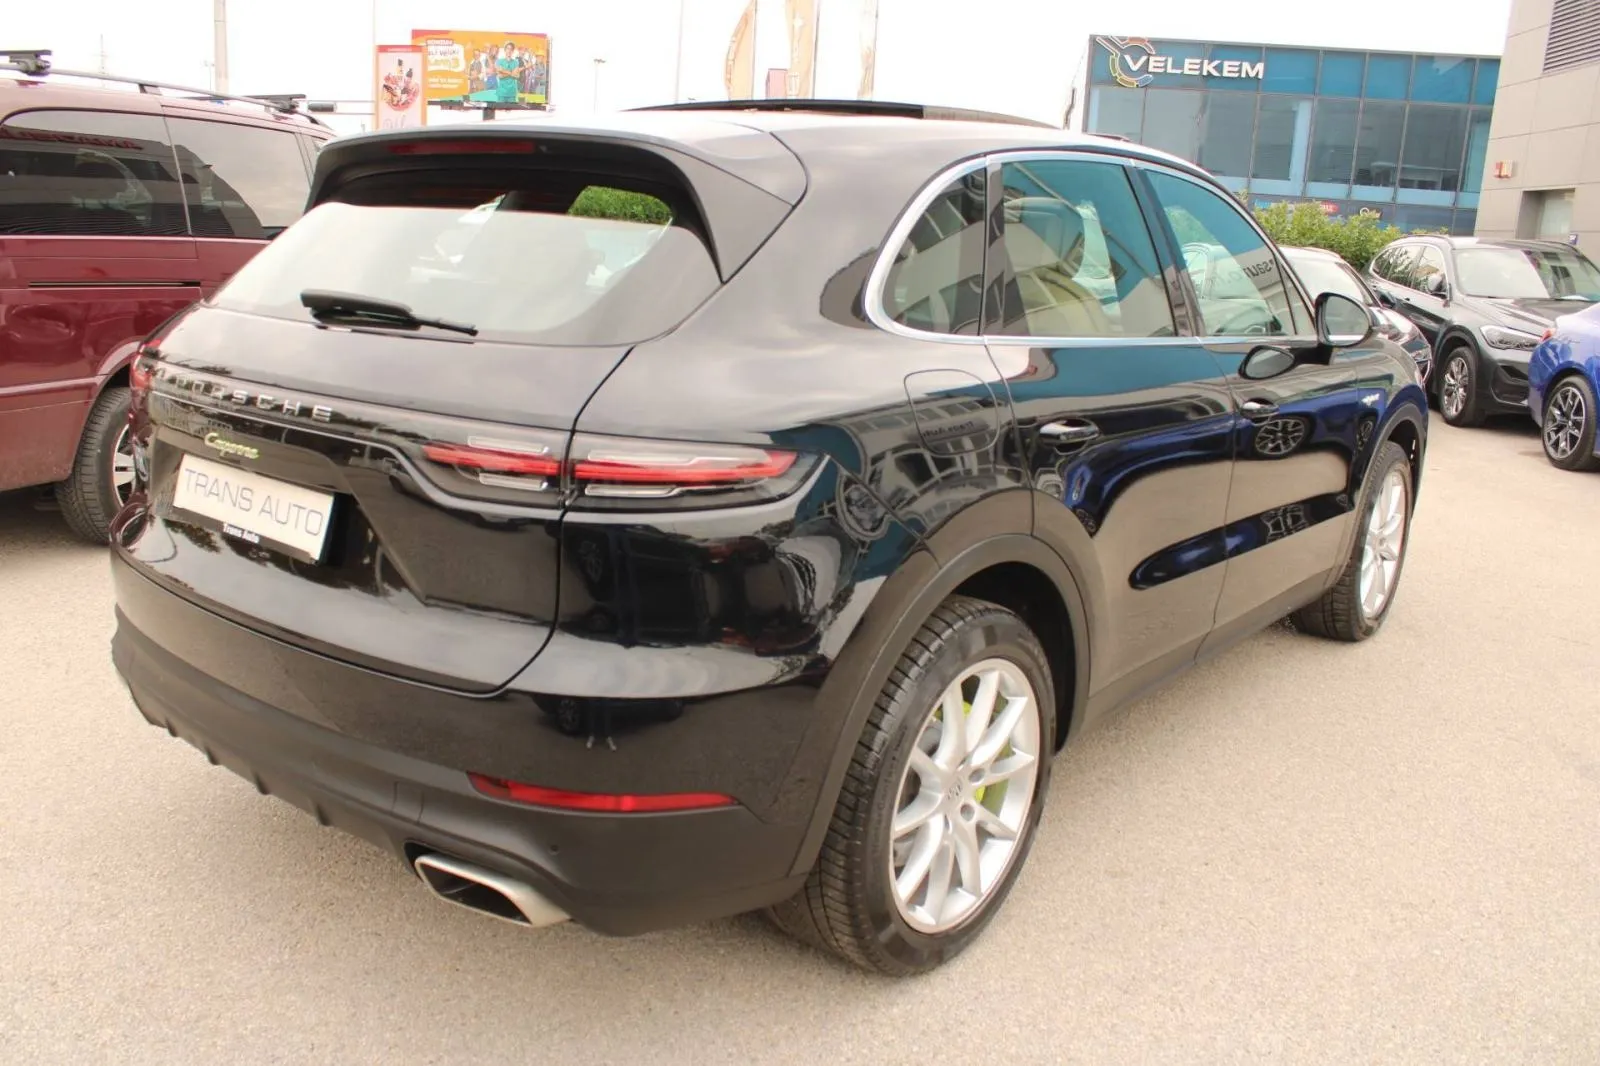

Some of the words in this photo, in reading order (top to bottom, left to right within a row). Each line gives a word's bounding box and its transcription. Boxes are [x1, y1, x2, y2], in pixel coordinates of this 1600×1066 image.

[1124, 54, 1265, 80] VELEKEM
[175, 373, 333, 423] PORSCHE
[184, 467, 254, 513] TRANS
[258, 494, 324, 537] AUTO
